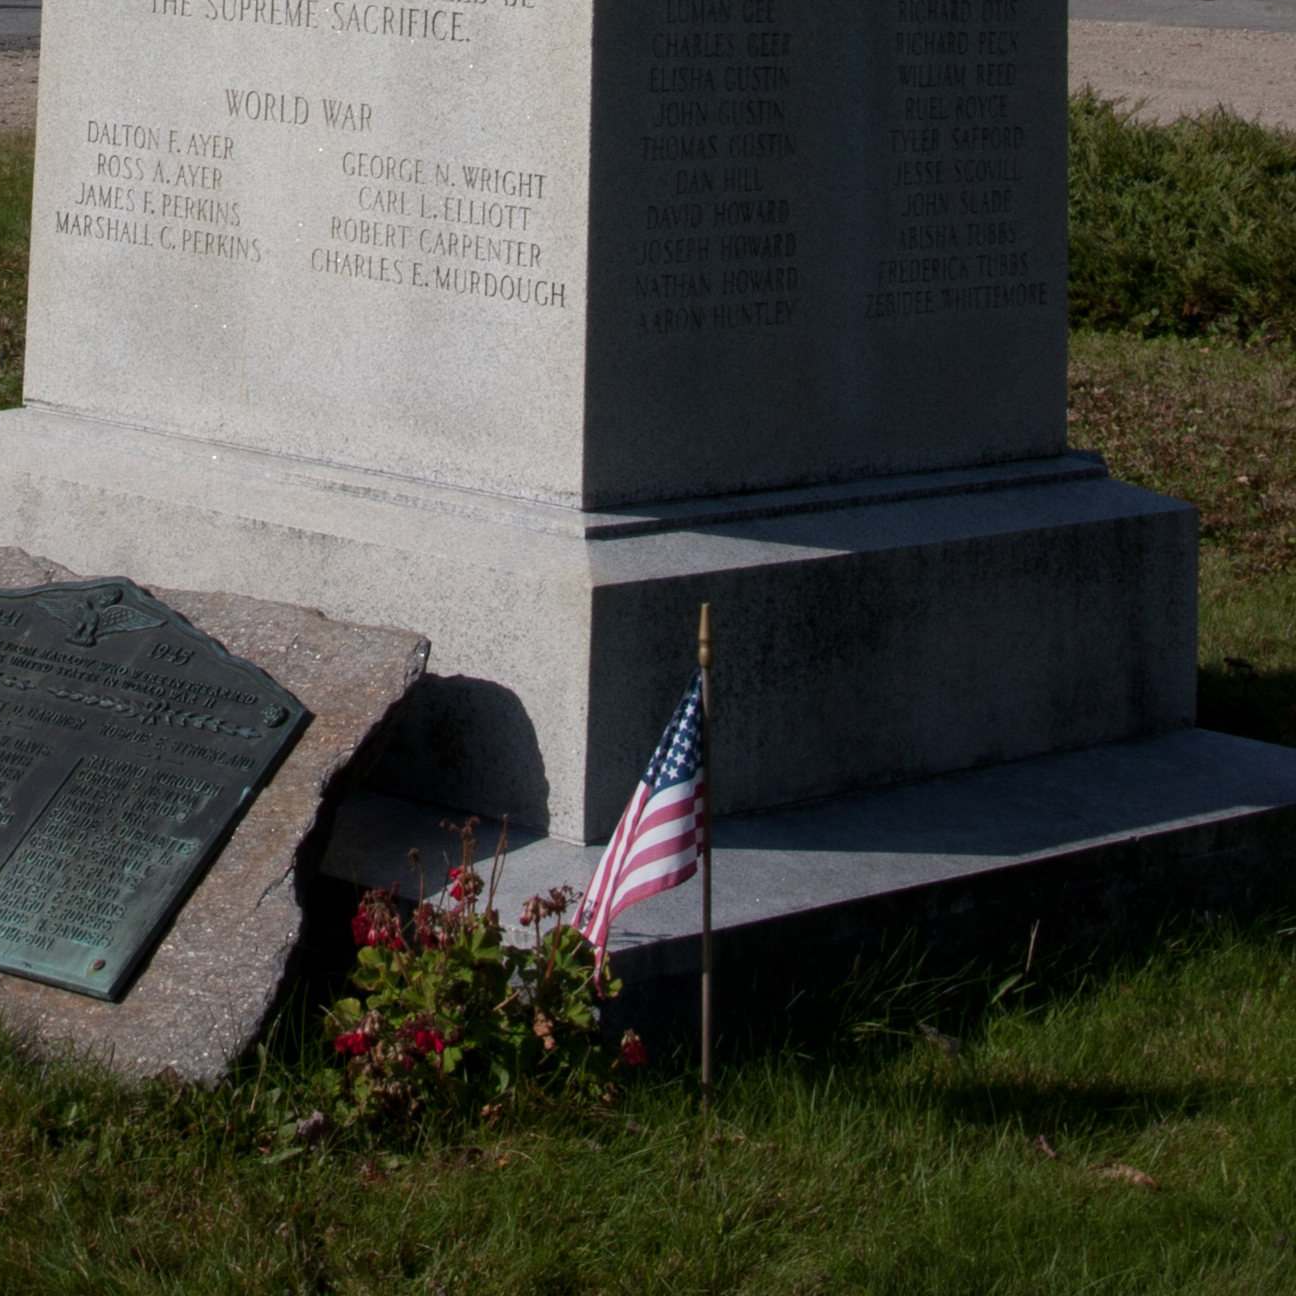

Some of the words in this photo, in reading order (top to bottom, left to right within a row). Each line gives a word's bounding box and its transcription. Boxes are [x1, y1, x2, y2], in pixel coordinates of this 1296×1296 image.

[331, 2, 470, 42] SACRIFICE.
[649, 67, 715, 93] ELISHA
[724, 66, 790, 91] GUSTIN
[225, 89, 309, 125] WORLD
[323, 99, 373, 132] WAR
[87, 120, 160, 151] DALTON
[188, 132, 234, 160] AYER
[641, 135, 718, 161] THOMAS
[729, 133, 795, 158] GUSTIN
[97, 153, 144, 181] ROSS
[176, 163, 223, 190] AYER
[342, 152, 423, 184] GEORGE
[463, 165, 547, 199] WRIGHT
[76, 183, 135, 213] JAMES
[162, 193, 241, 226] PERKINS
[359, 186, 411, 215] CARL
[444, 197, 532, 231] ELLIOTT
[55, 211, 153, 247] MARSHALL
[182, 229, 262, 263] PERKINS
[331, 217, 407, 249] ROBERT
[420, 228, 542, 268] CARPENTER
[311, 248, 403, 284] CHARLES
[436, 266, 566, 308] MURDOUGH
[4, 641, 37, 656] FROM
[40, 649, 97, 668] MARLOW
[99, 661, 127, 675] WHO
[130, 667, 168, 685] WERE
[169, 676, 184, 688] IN
[185, 680, 209, 694] THE
[209, 686, 258, 704] ARMED
[148, 643, 194, 665] 1945
[9, 657, 53, 673] UNITED
[56, 666, 99, 683] STATES
[103, 672, 118, 687] IN
[121, 677, 166, 697] WORLD
[170, 688, 197, 704] WAR
[203, 698, 216, 708] II
